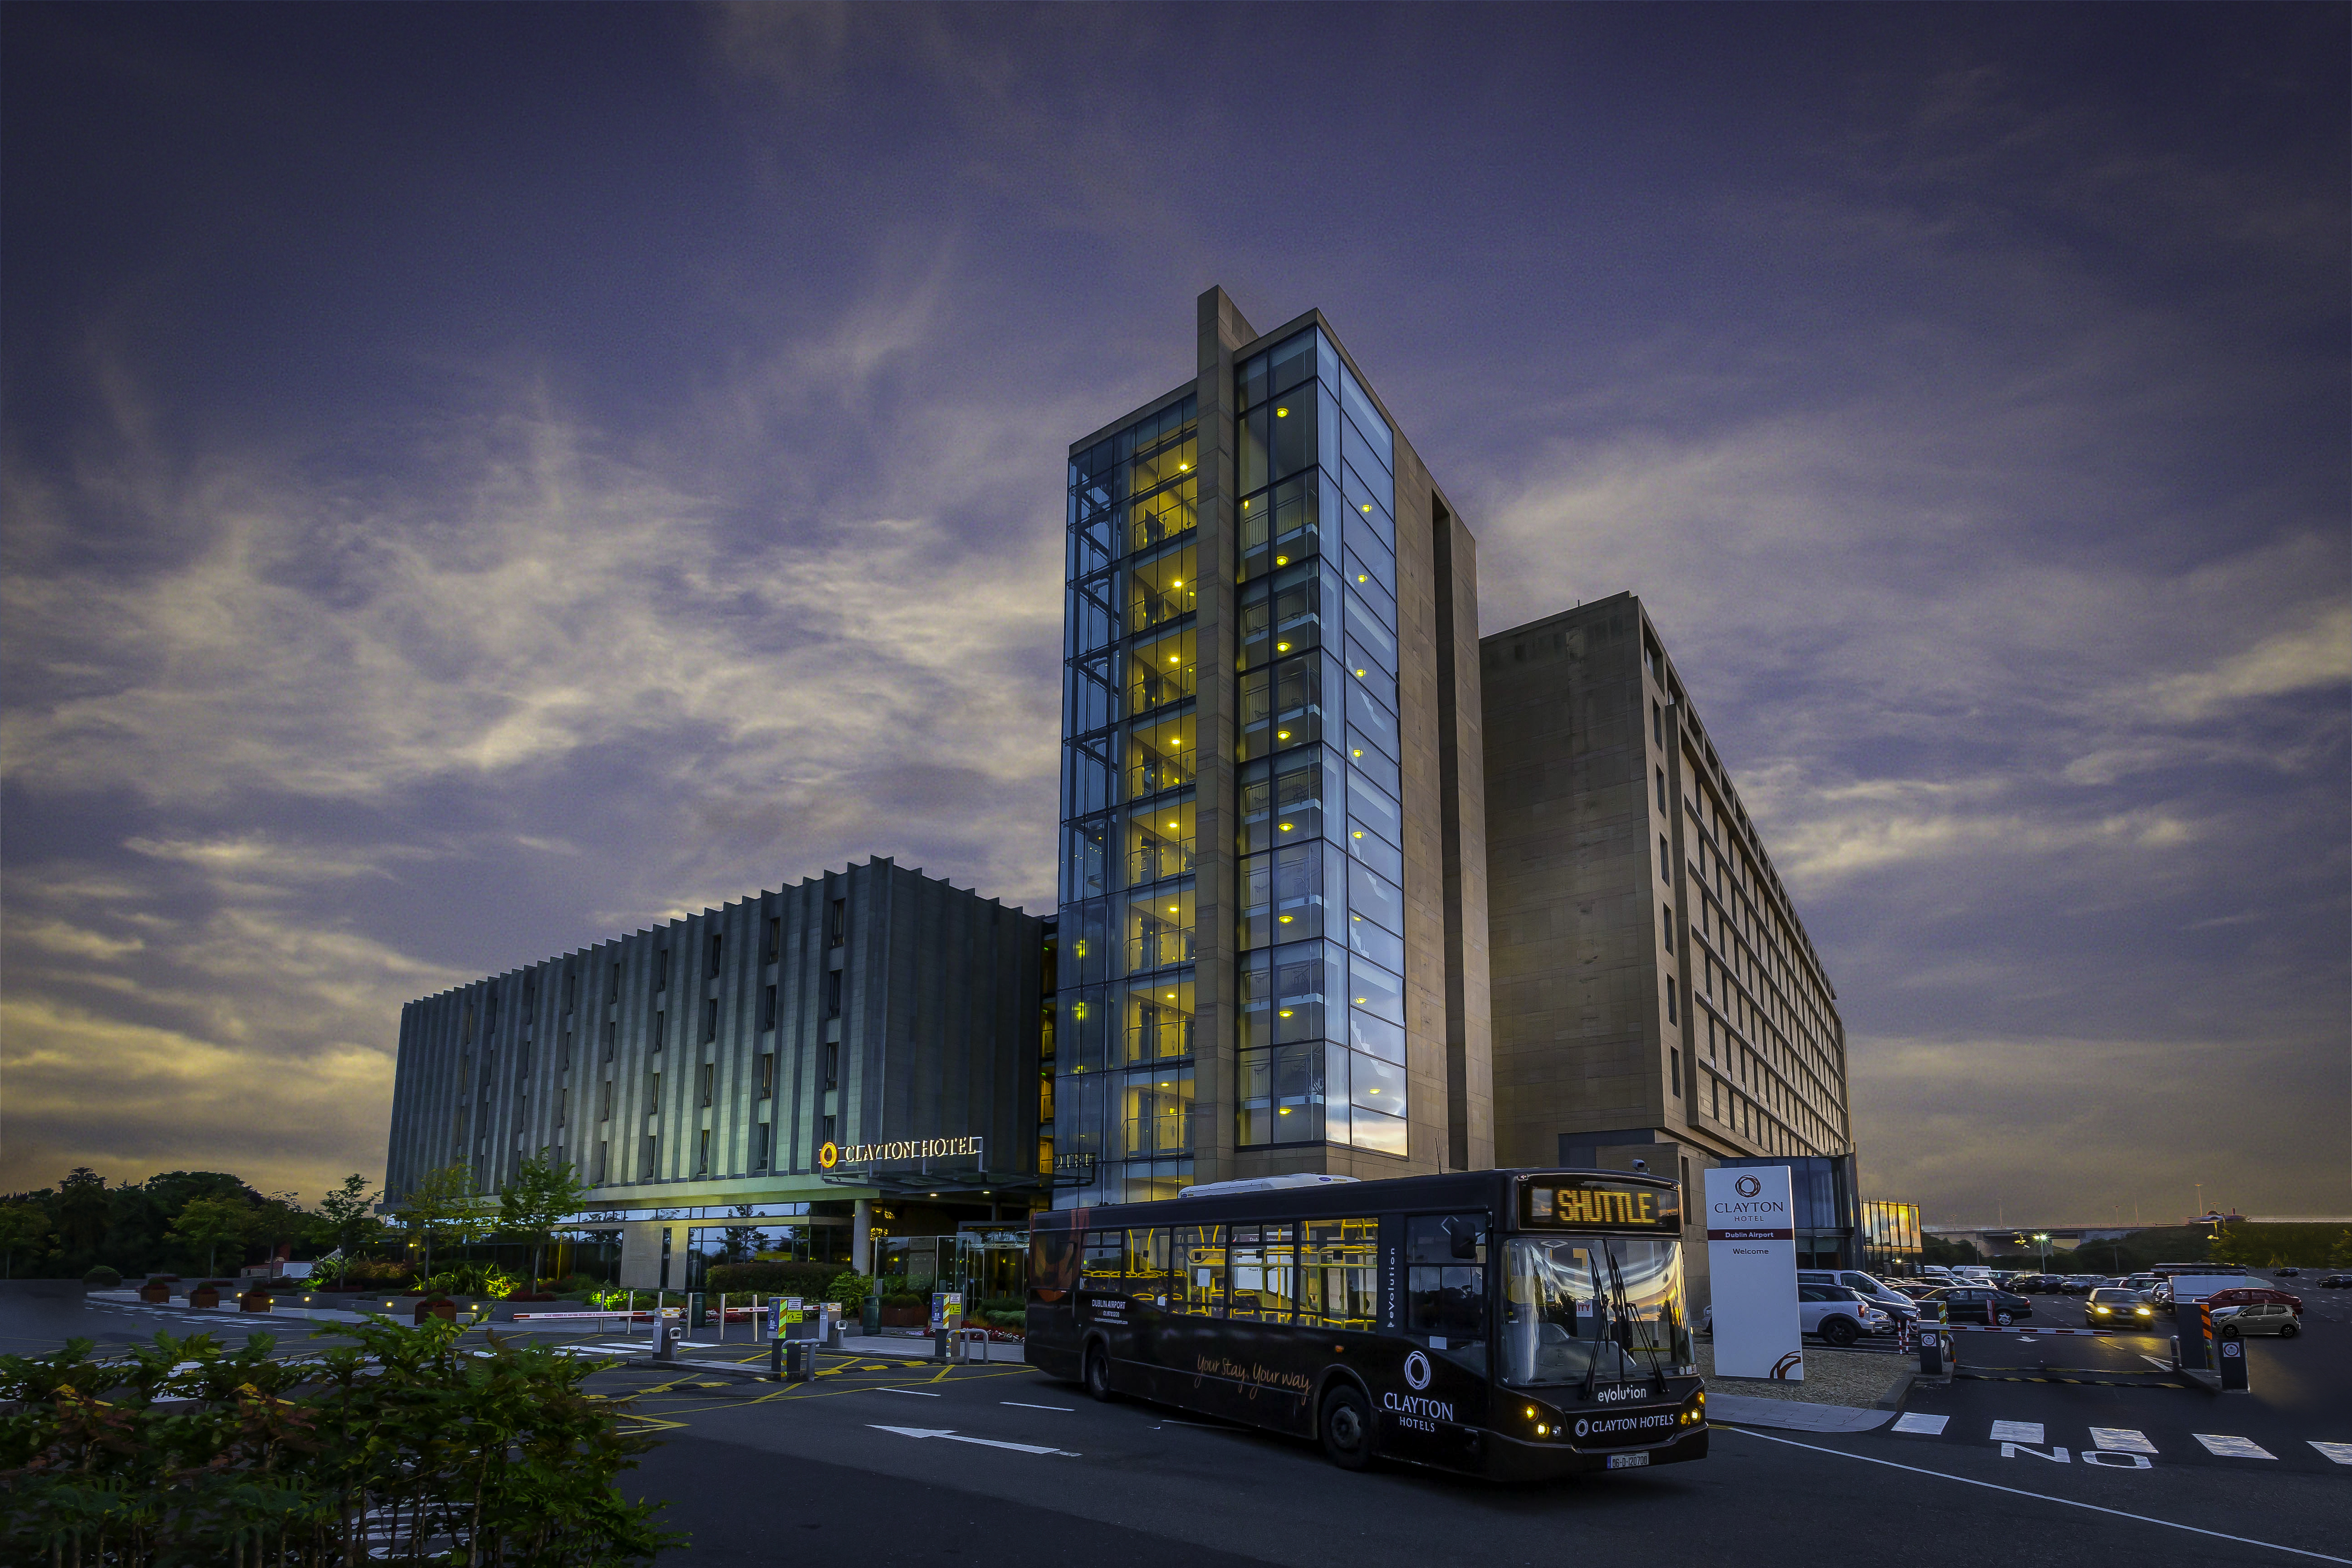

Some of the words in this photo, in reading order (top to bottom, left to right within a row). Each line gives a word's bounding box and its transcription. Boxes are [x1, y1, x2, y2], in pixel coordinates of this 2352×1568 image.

[846, 1140, 915, 1163] CLAYTON
[922, 1137, 976, 1157] HOTEL
[1557, 1189, 1656, 1223] SHUTTLE
[1714, 1201, 1784, 1213] CLAYTON
[1092, 1299, 1107, 1308] DUBLIN
[1107, 1300, 1126, 1309] AIRPORT
[1384, 1392, 1453, 1422] CLAYTON
[1400, 1416, 1435, 1432] HOTELS
[1592, 1417, 1637, 1432] CLAYTON
[1640, 1414, 1674, 1428] HOTELS
